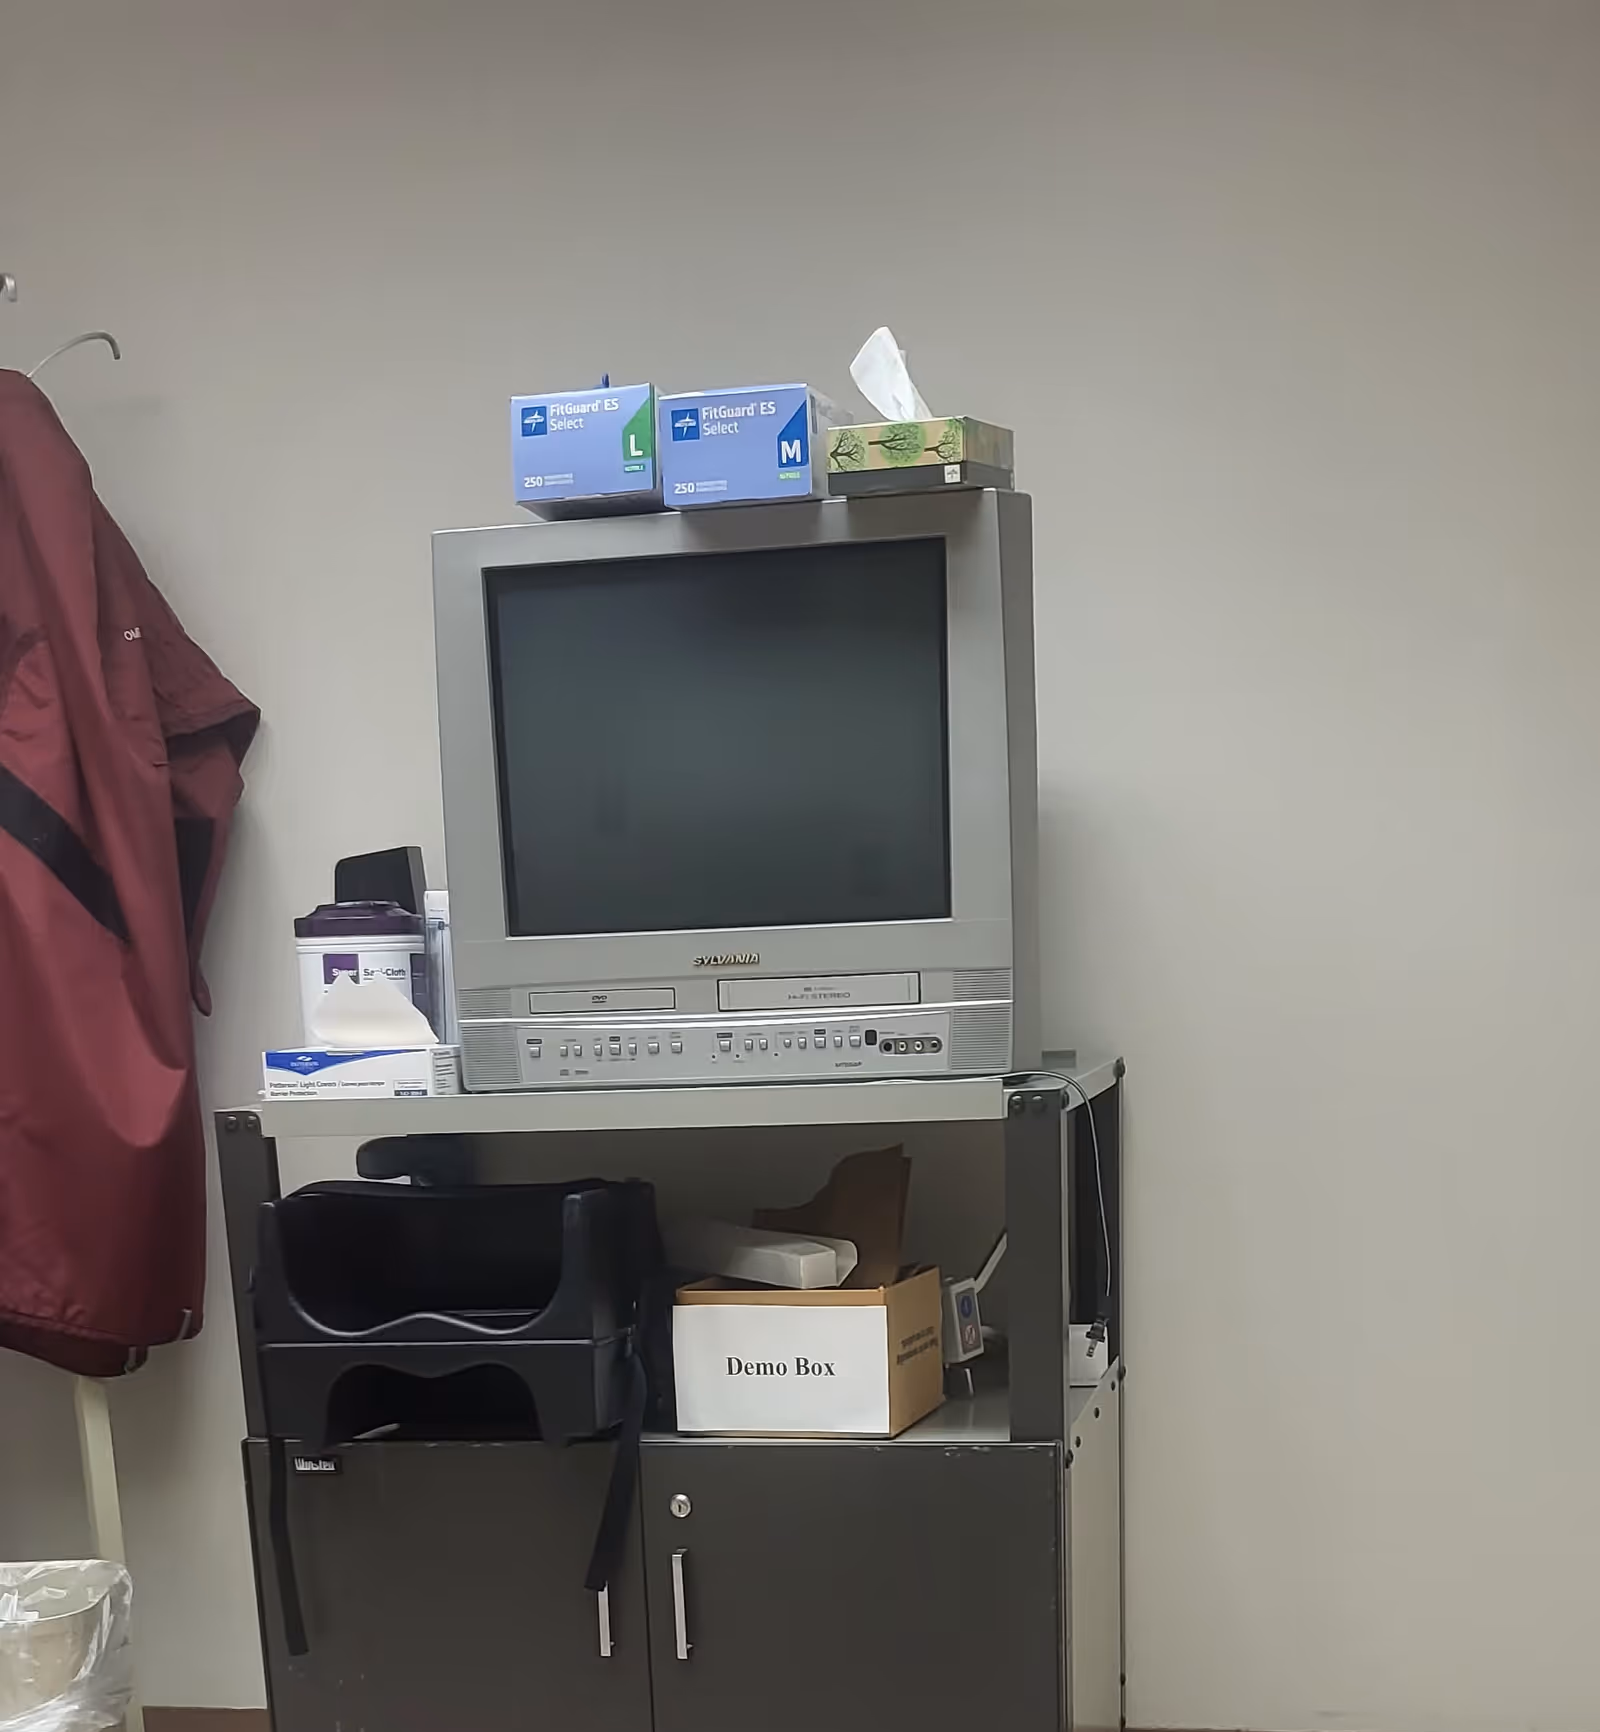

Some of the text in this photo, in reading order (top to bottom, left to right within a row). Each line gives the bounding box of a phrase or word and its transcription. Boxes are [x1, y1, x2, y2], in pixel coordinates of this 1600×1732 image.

[603, 398, 620, 412] ES
[760, 401, 777, 415] ES
[549, 417, 585, 431] Select
[703, 421, 740, 436] Select
[629, 433, 644, 457] L
[781, 439, 802, 464] M
[523, 476, 543, 488] 250
[674, 482, 695, 494] 250
[692, 953, 760, 967] SYLVANIA
[591, 994, 608, 1004] DVD
[725, 1356, 836, 1377] Demo Box
